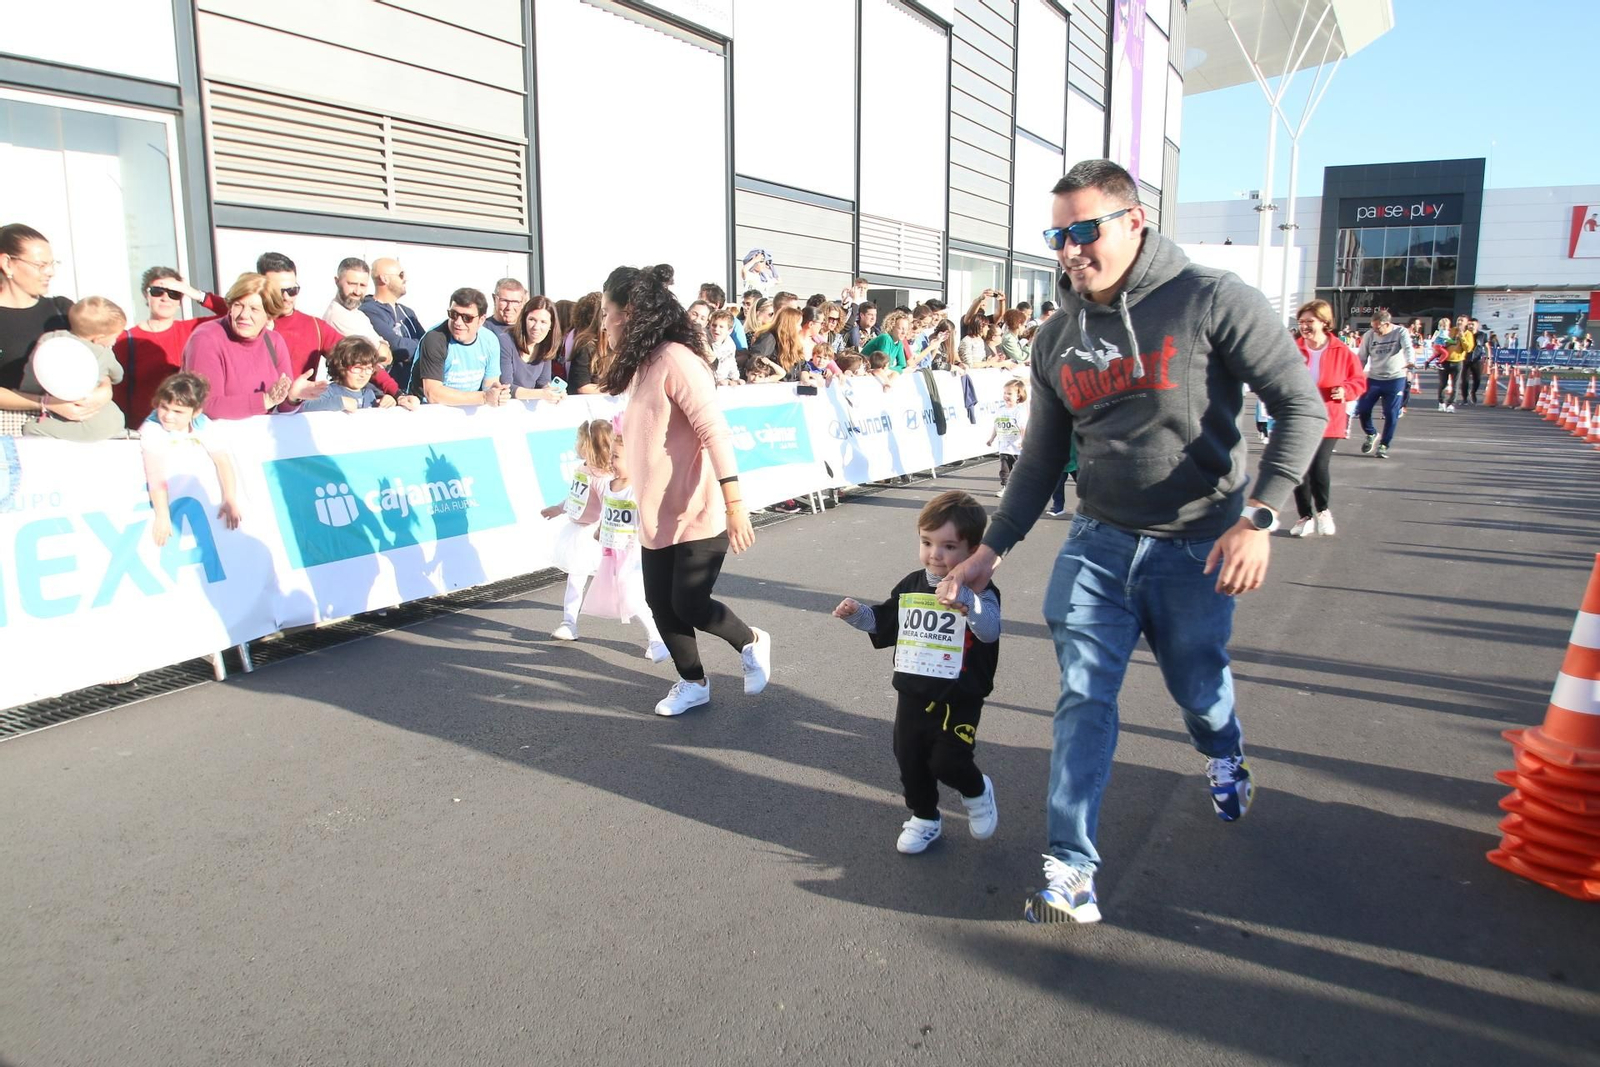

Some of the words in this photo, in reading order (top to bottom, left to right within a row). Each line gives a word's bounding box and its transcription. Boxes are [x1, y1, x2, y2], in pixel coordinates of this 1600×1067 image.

[364, 477, 476, 518] cajamar
[427, 502, 450, 515] CAJA
[919, 632, 952, 642] CARRERA
